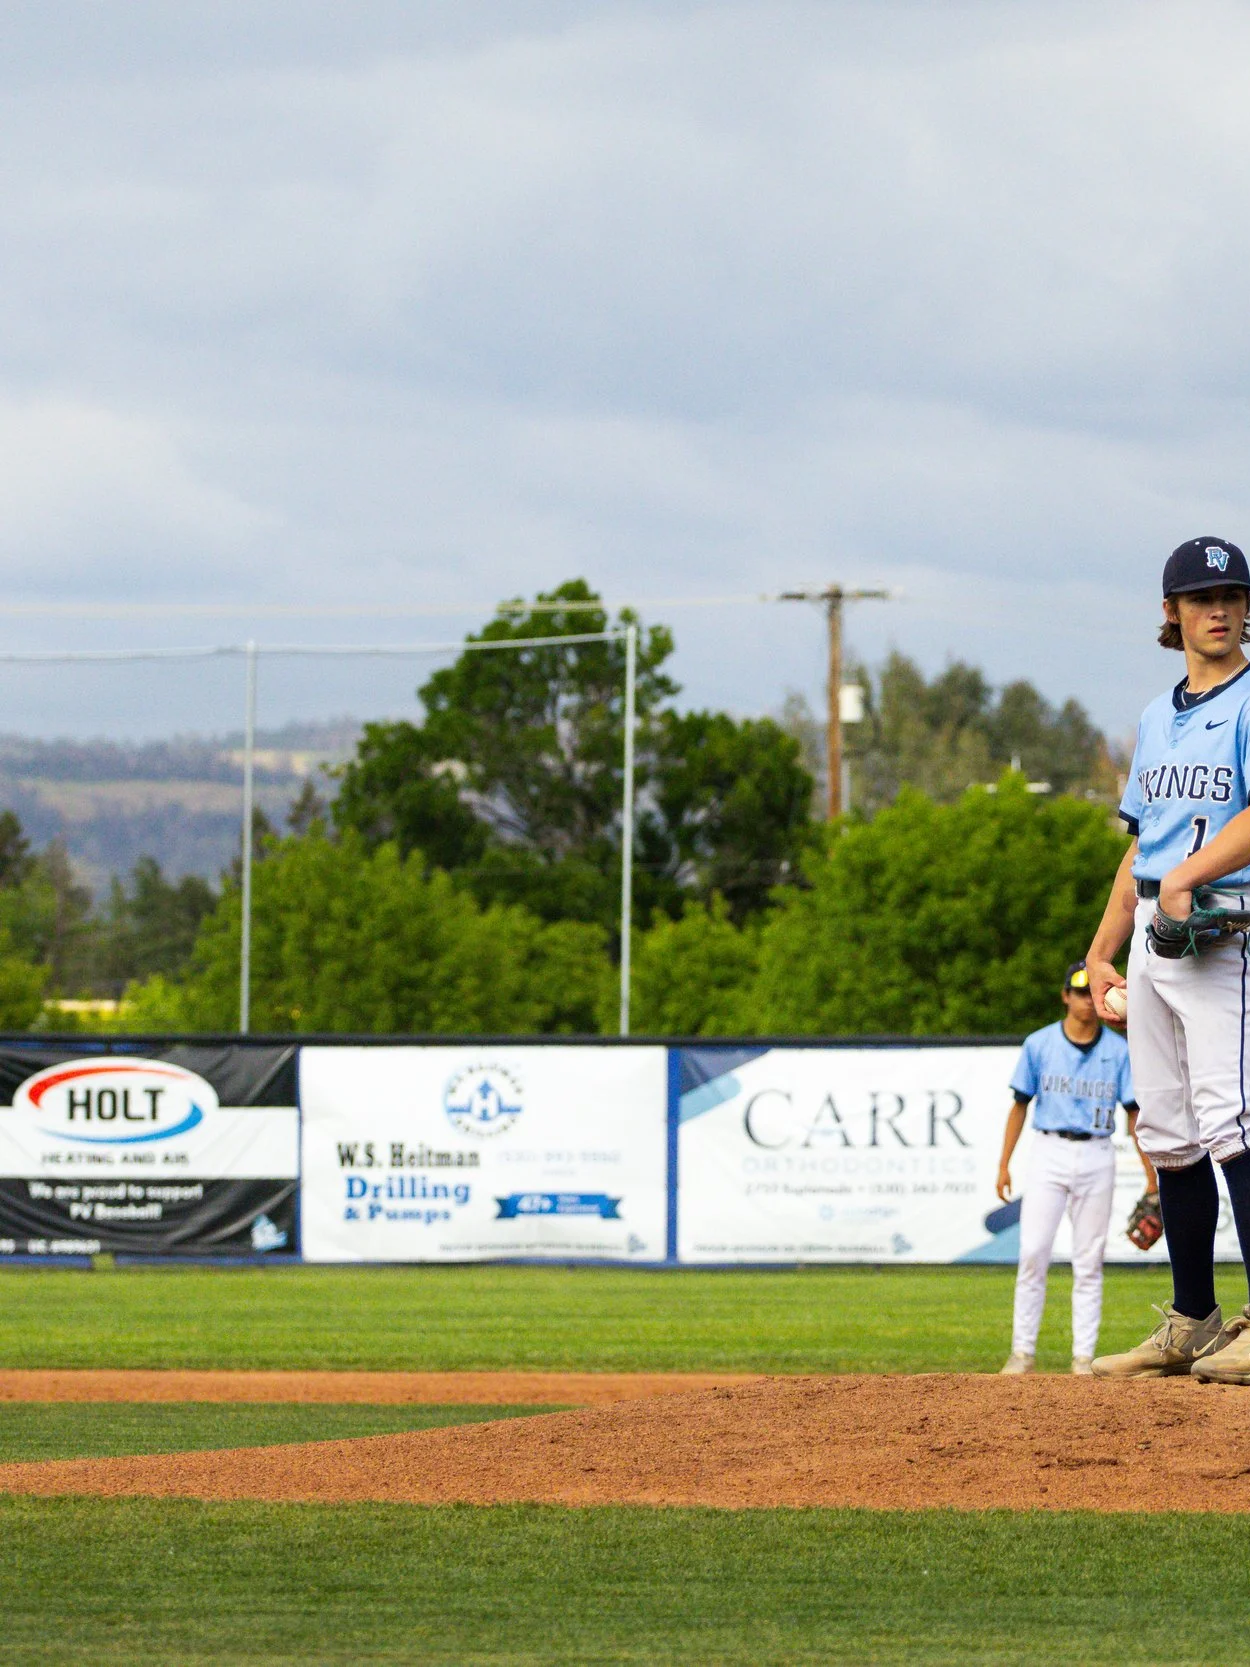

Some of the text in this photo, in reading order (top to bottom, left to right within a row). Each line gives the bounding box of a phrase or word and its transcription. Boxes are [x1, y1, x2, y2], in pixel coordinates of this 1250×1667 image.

[1040, 1074, 1117, 1099] VIKINGS
[68, 1089, 164, 1121] HOLT
[743, 1089, 973, 1149] CARR
[337, 1142, 382, 1167] W.S.
[390, 1142, 480, 1167] Heitman
[743, 1156, 978, 1175] ORTHODONTICS
[346, 1175, 470, 1205] Drilling
[366, 1203, 452, 1225] Pumps
